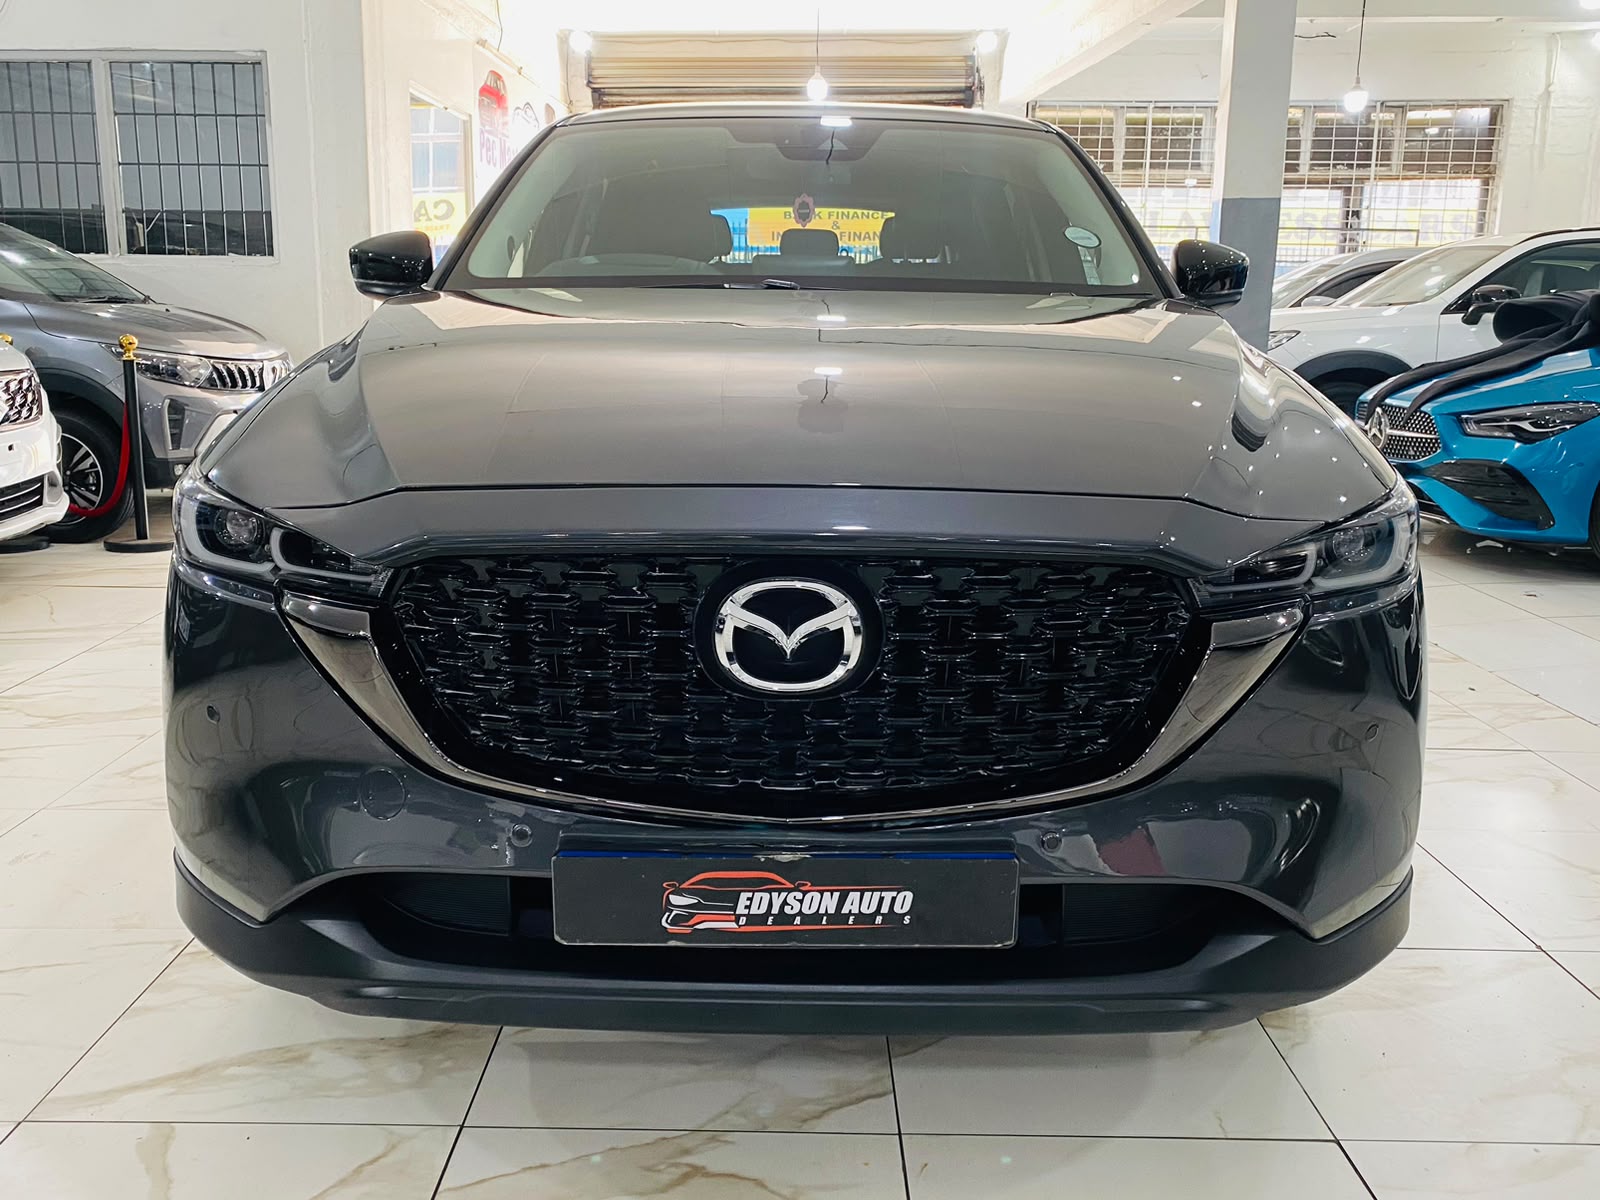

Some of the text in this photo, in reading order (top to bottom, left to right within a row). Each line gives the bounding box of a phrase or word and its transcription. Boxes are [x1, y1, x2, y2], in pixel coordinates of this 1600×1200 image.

[783, 210, 890, 220] BK FINANCE
[831, 220, 841, 230] &
[735, 890, 914, 915] EDYSON AUTO
[739, 915, 911, 926] DEALERS
